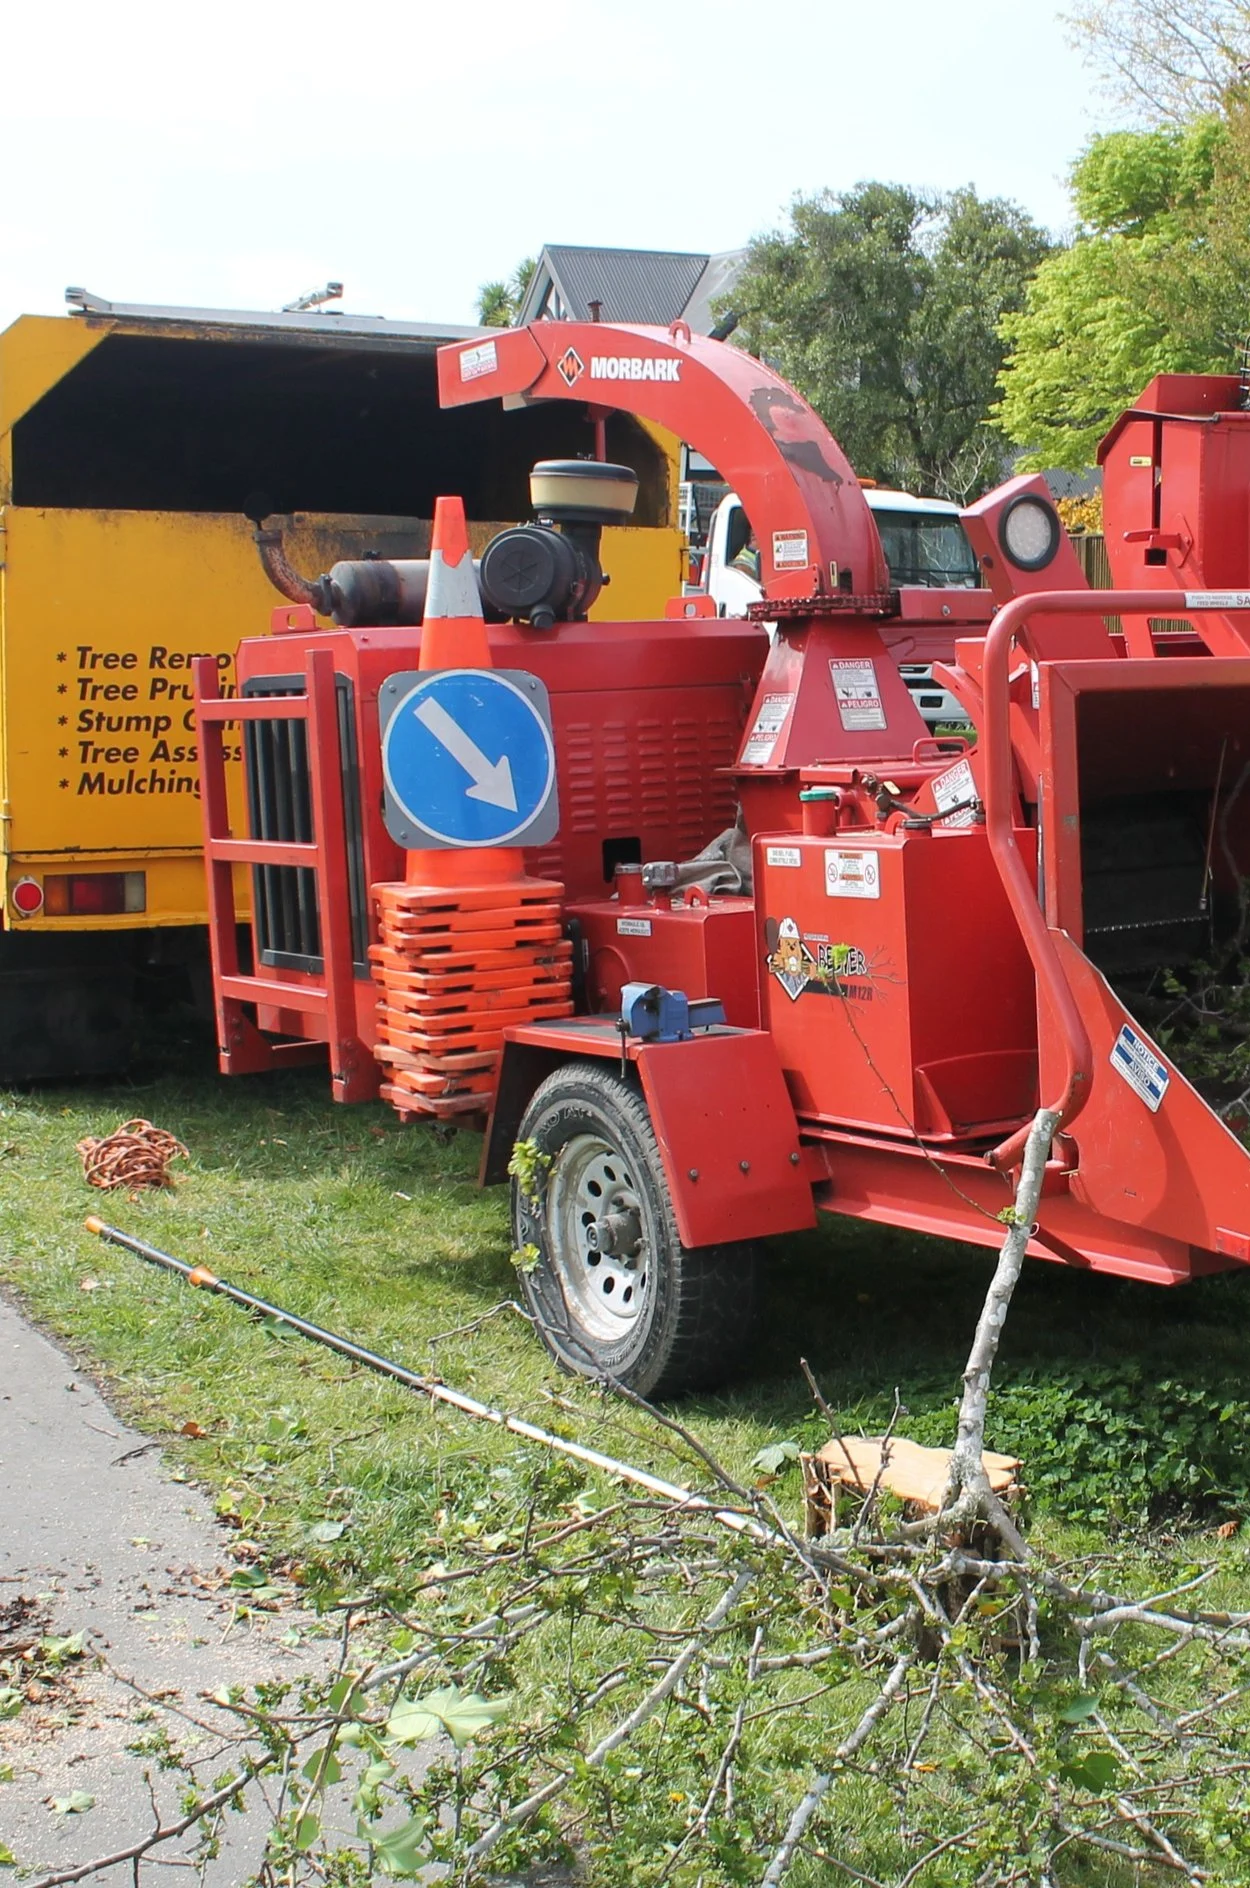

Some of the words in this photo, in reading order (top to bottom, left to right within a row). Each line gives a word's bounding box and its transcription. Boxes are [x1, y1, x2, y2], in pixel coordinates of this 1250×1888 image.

[590, 356, 681, 381] MORBARK
[76, 646, 138, 669] Tree
[148, 646, 236, 669] Reo
[838, 661, 871, 669] DANGER
[77, 678, 138, 701] Tree
[149, 676, 236, 701] Prui
[847, 700, 879, 708] PELIGRO
[76, 708, 172, 739] Stump
[78, 741, 139, 763] Tree
[149, 740, 242, 763] Assss
[940, 763, 967, 786] DANGER
[1132, 1038, 1160, 1073] NOTICE
